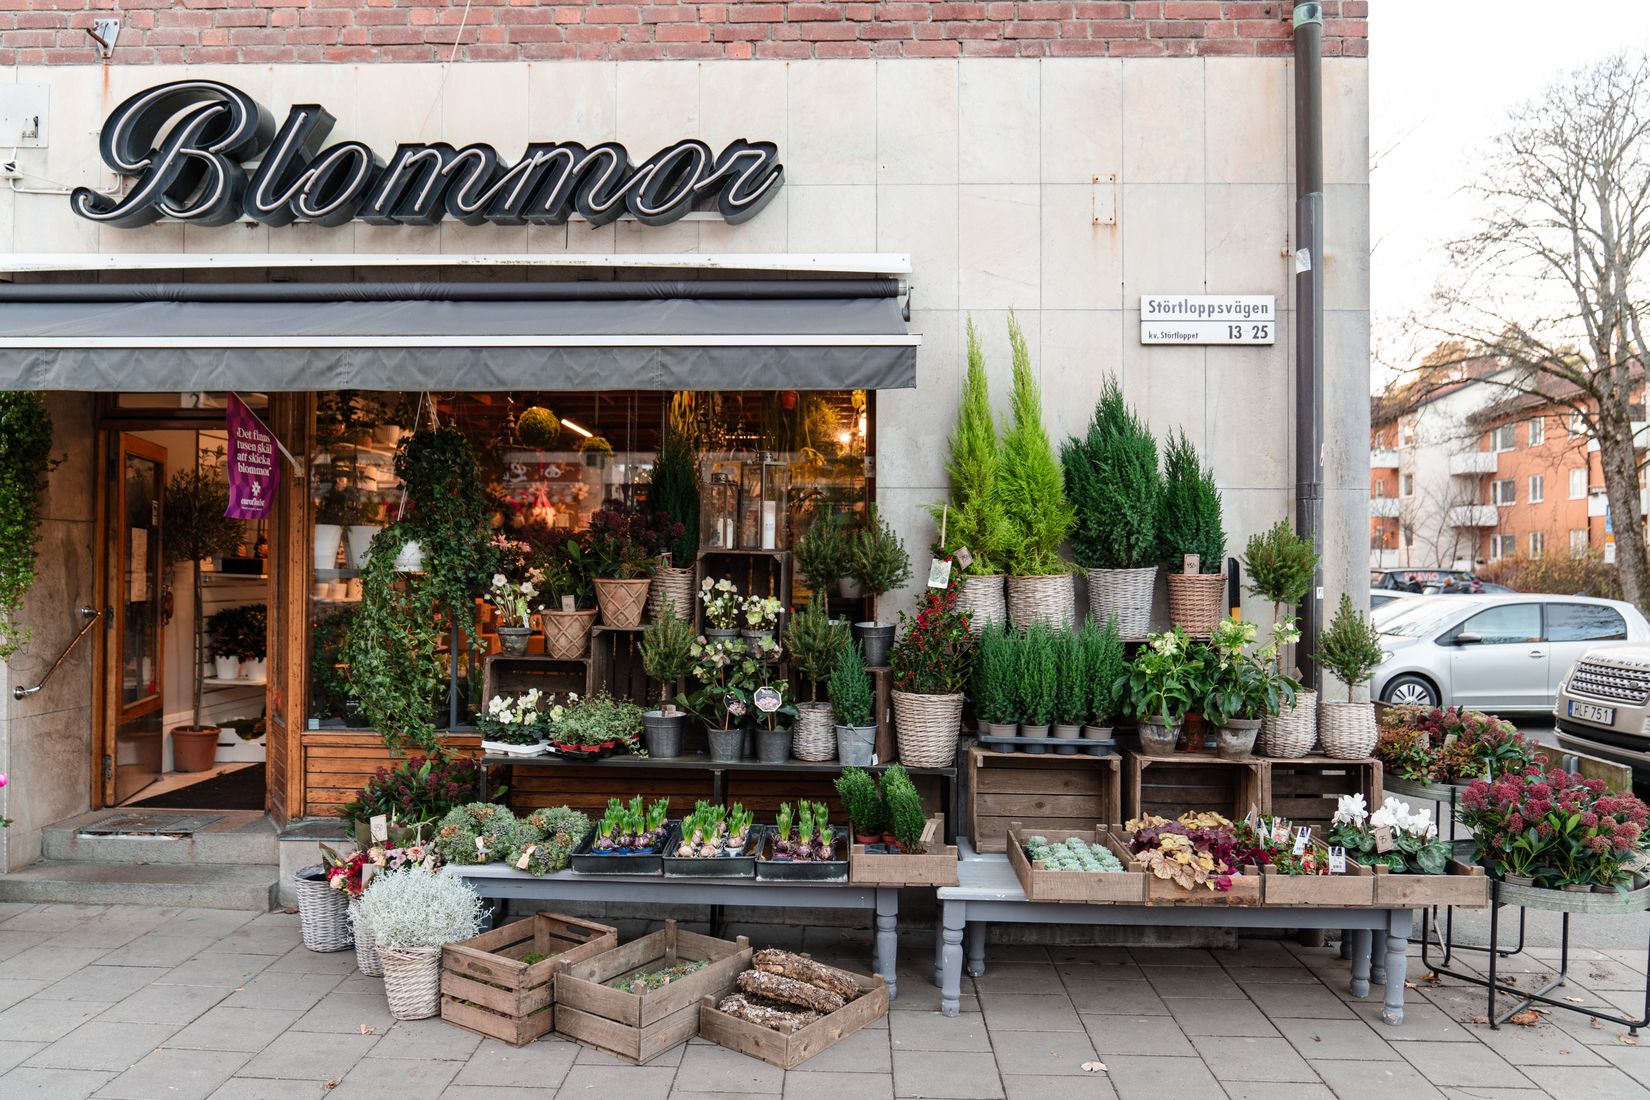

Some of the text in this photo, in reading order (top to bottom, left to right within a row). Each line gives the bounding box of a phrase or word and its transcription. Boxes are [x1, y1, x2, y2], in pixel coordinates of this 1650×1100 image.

[71, 79, 785, 228] Blommor
[1148, 298, 1269, 318] Störtloppsvägen
[1148, 330, 1199, 341] kv. Störtloppet
[1227, 325, 1268, 339] 13 25
[236, 428, 270, 442] Det finns
[237, 440, 271, 454] tusen skäl
[236, 452, 271, 465] att skicka
[1574, 702, 1608, 722] HLF 751
